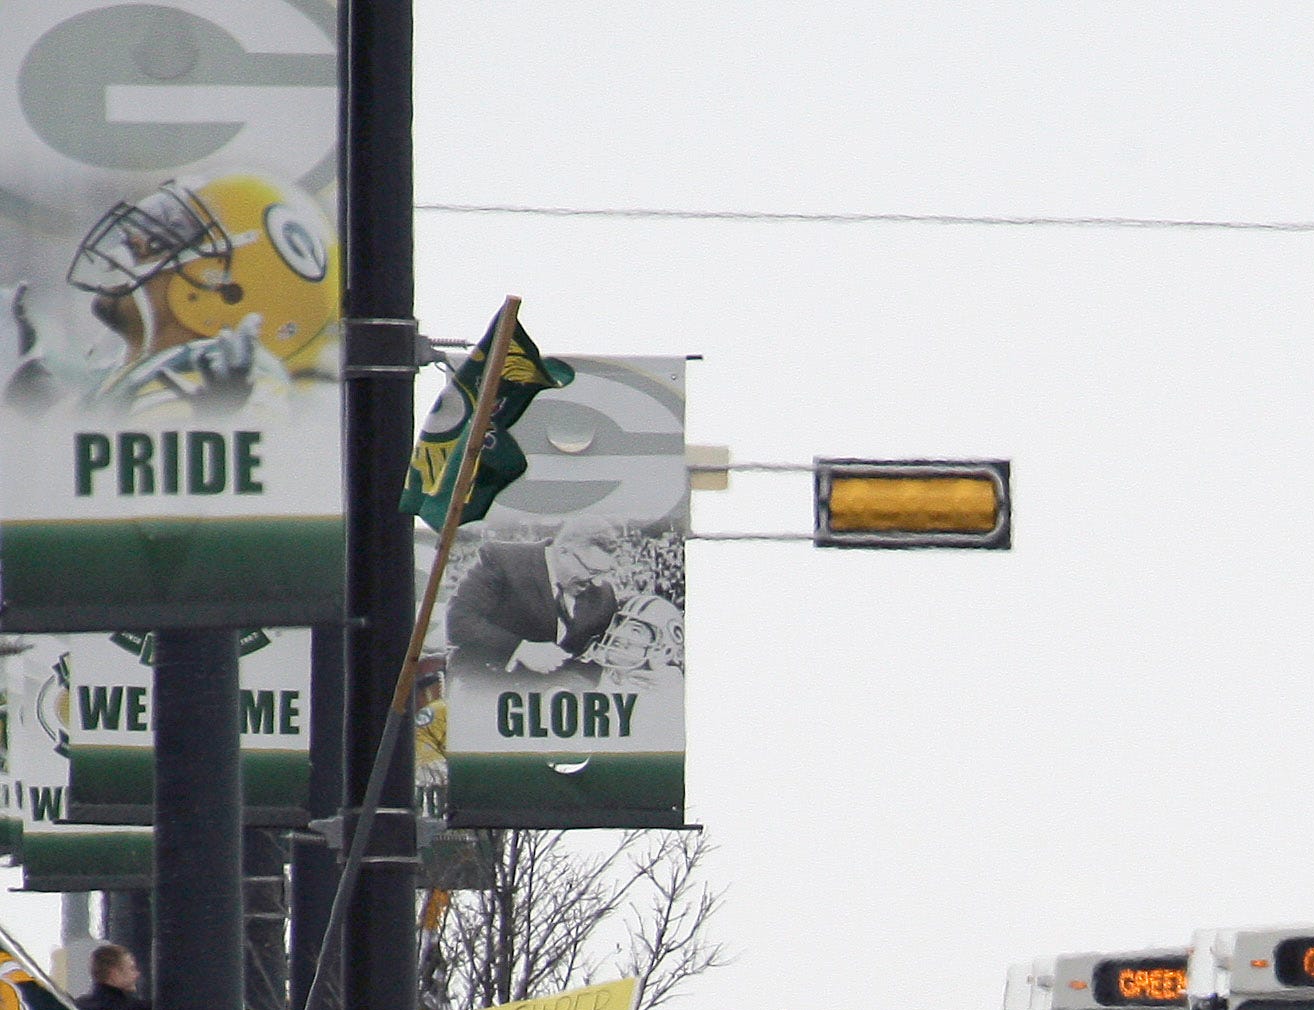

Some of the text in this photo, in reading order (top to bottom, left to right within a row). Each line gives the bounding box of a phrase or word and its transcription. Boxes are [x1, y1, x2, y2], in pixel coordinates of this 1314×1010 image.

[74, 430, 264, 497] PRIDE
[77, 685, 299, 735] WEME
[496, 691, 639, 739] GLORY
[1118, 967, 1188, 999] GREE
